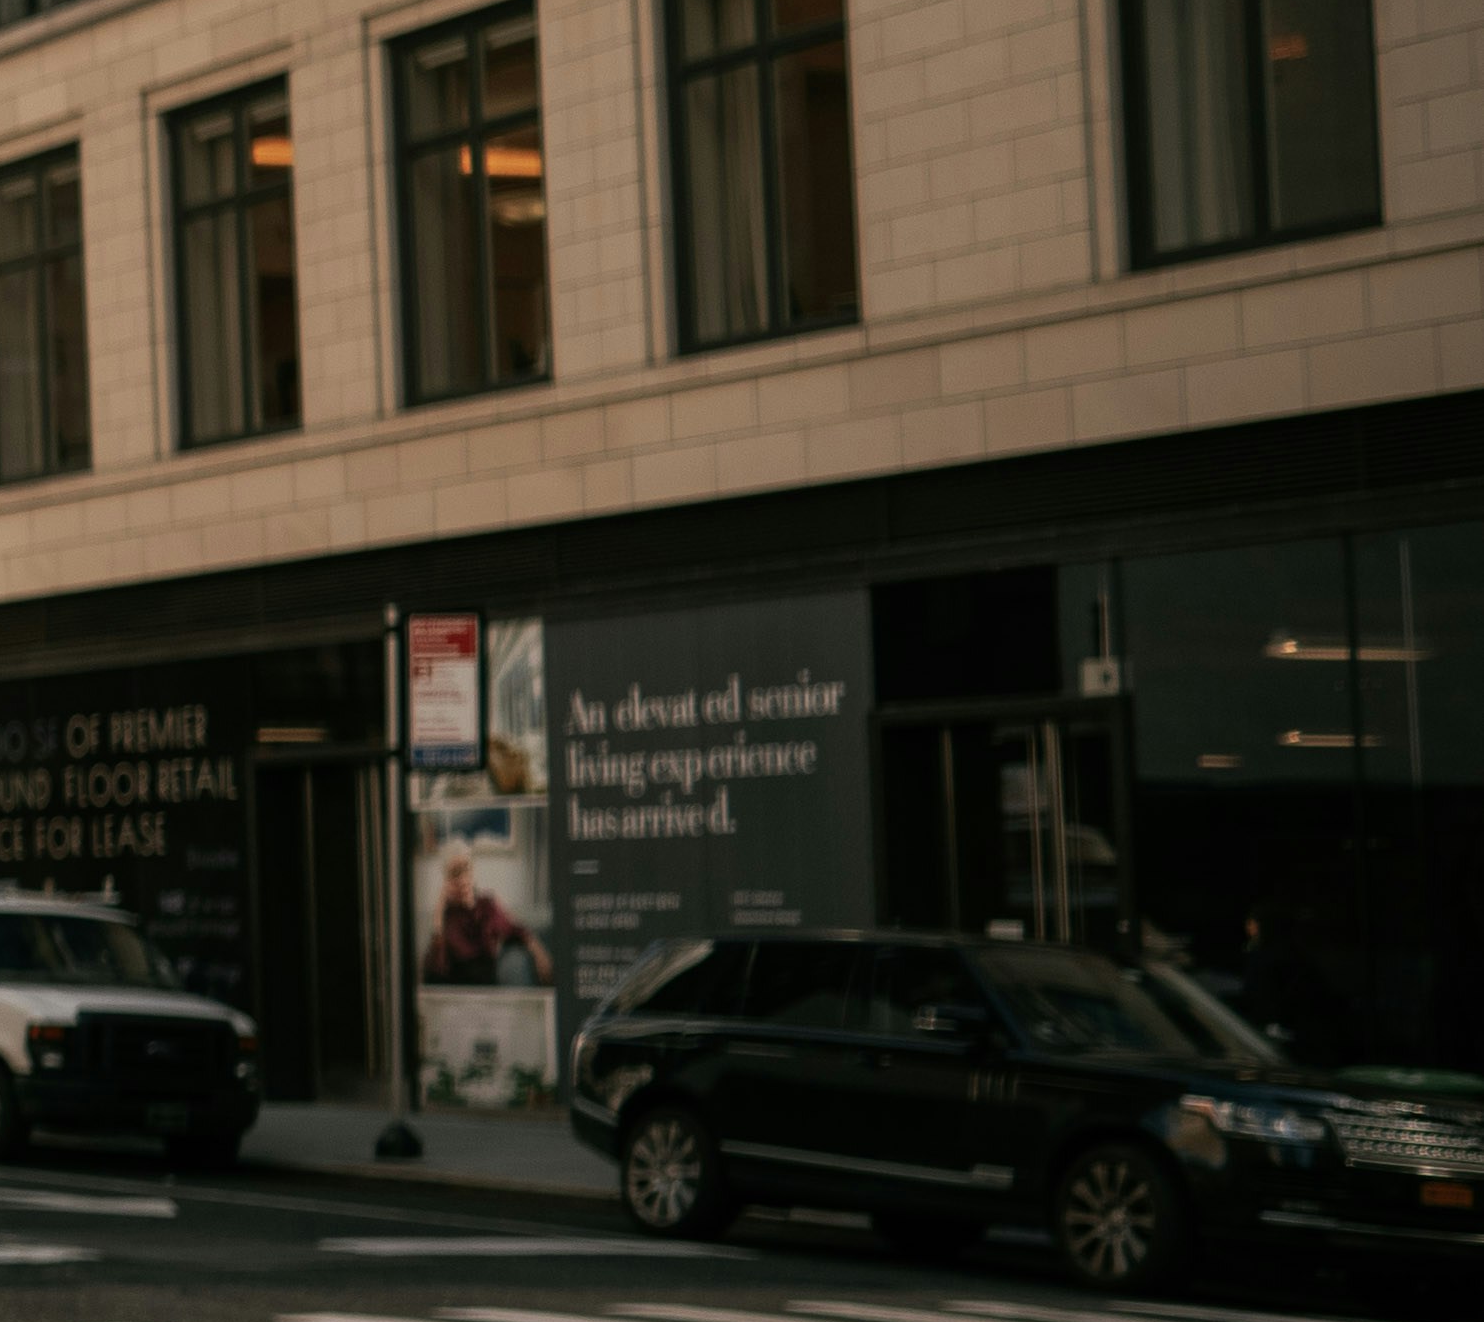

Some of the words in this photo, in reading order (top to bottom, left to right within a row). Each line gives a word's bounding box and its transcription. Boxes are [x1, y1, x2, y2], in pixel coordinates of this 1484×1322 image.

[569, 690, 605, 733] An
[749, 671, 844, 719] senior
[67, 714, 98, 757] OF
[110, 705, 208, 752] PREMIER
[63, 761, 149, 807] FLOOR
[159, 758, 237, 803] RETAIL
[568, 740, 645, 796] living
[35, 816, 82, 859] FOR
[93, 812, 167, 857] LEASE
[569, 794, 616, 838] has
